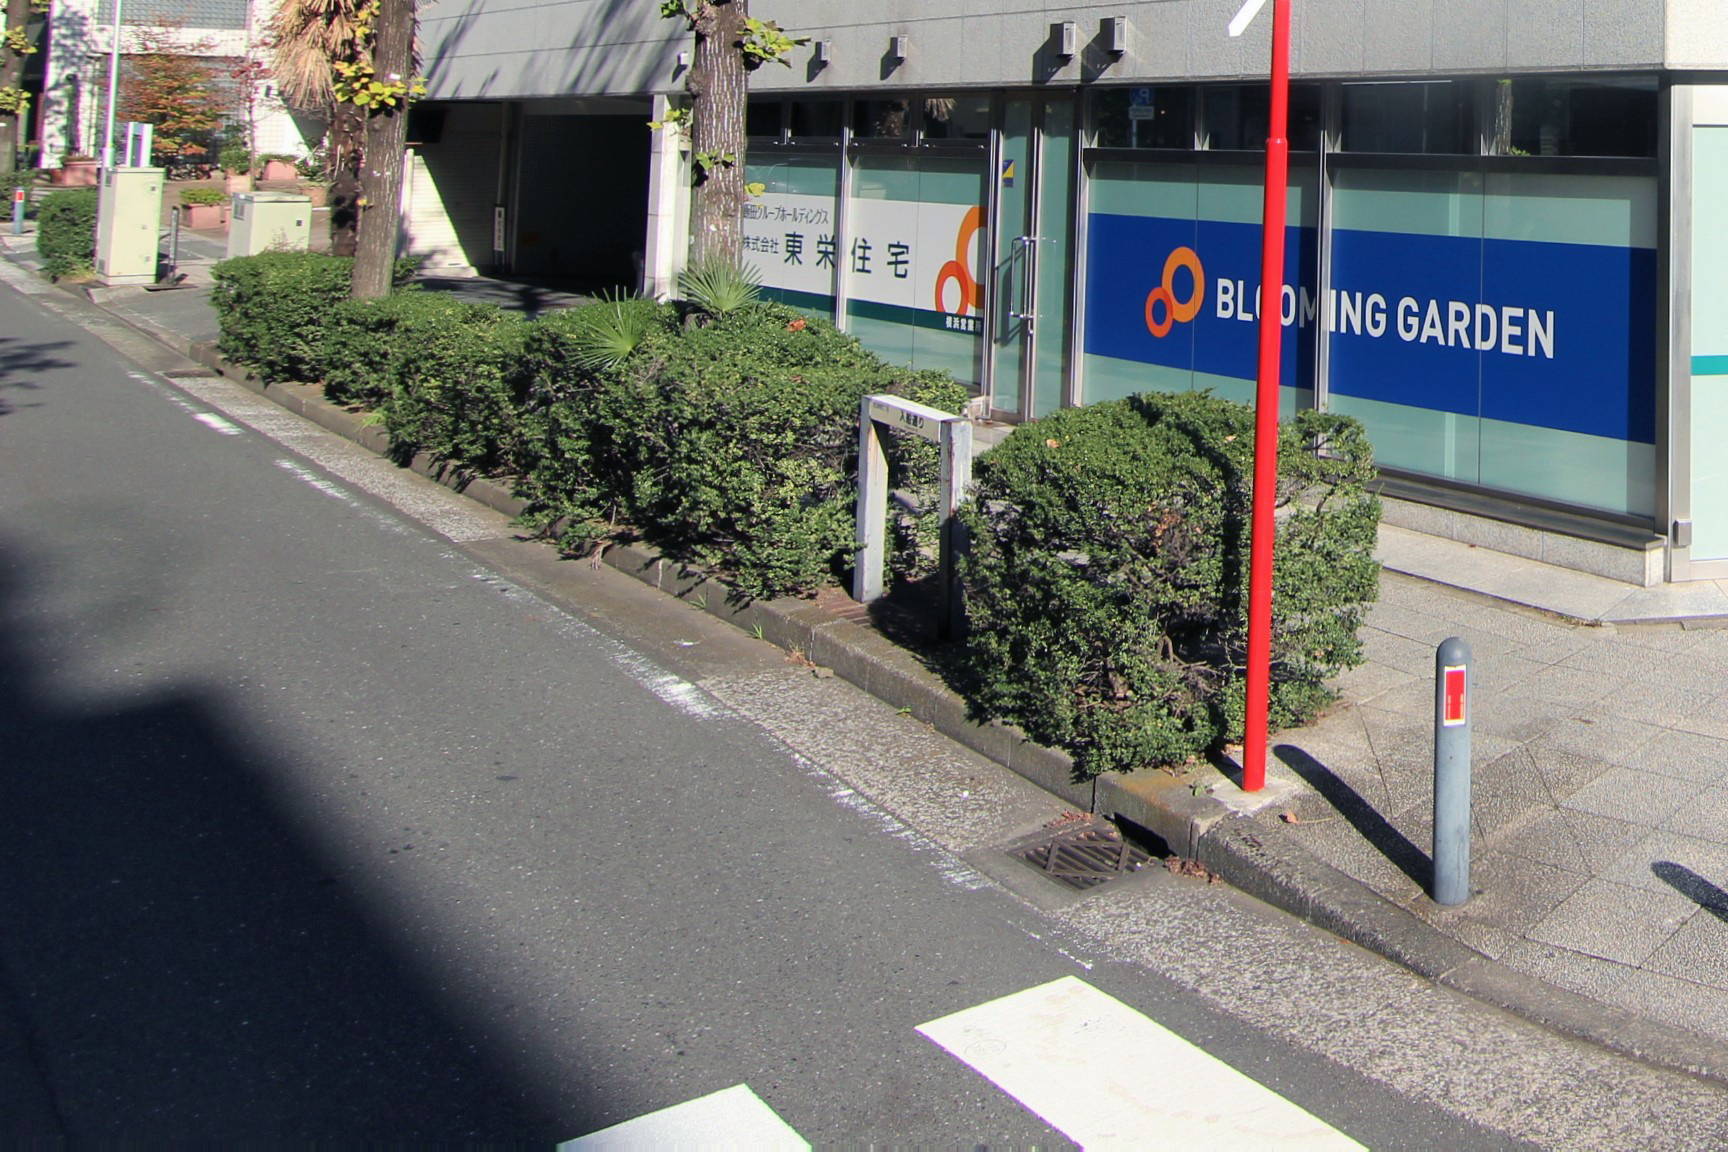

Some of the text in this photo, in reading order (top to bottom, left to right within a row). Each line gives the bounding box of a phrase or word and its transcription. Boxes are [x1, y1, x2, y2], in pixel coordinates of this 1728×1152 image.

[784, 230, 910, 279] 東栄住宅
[1396, 295, 1555, 360] GARDEN
